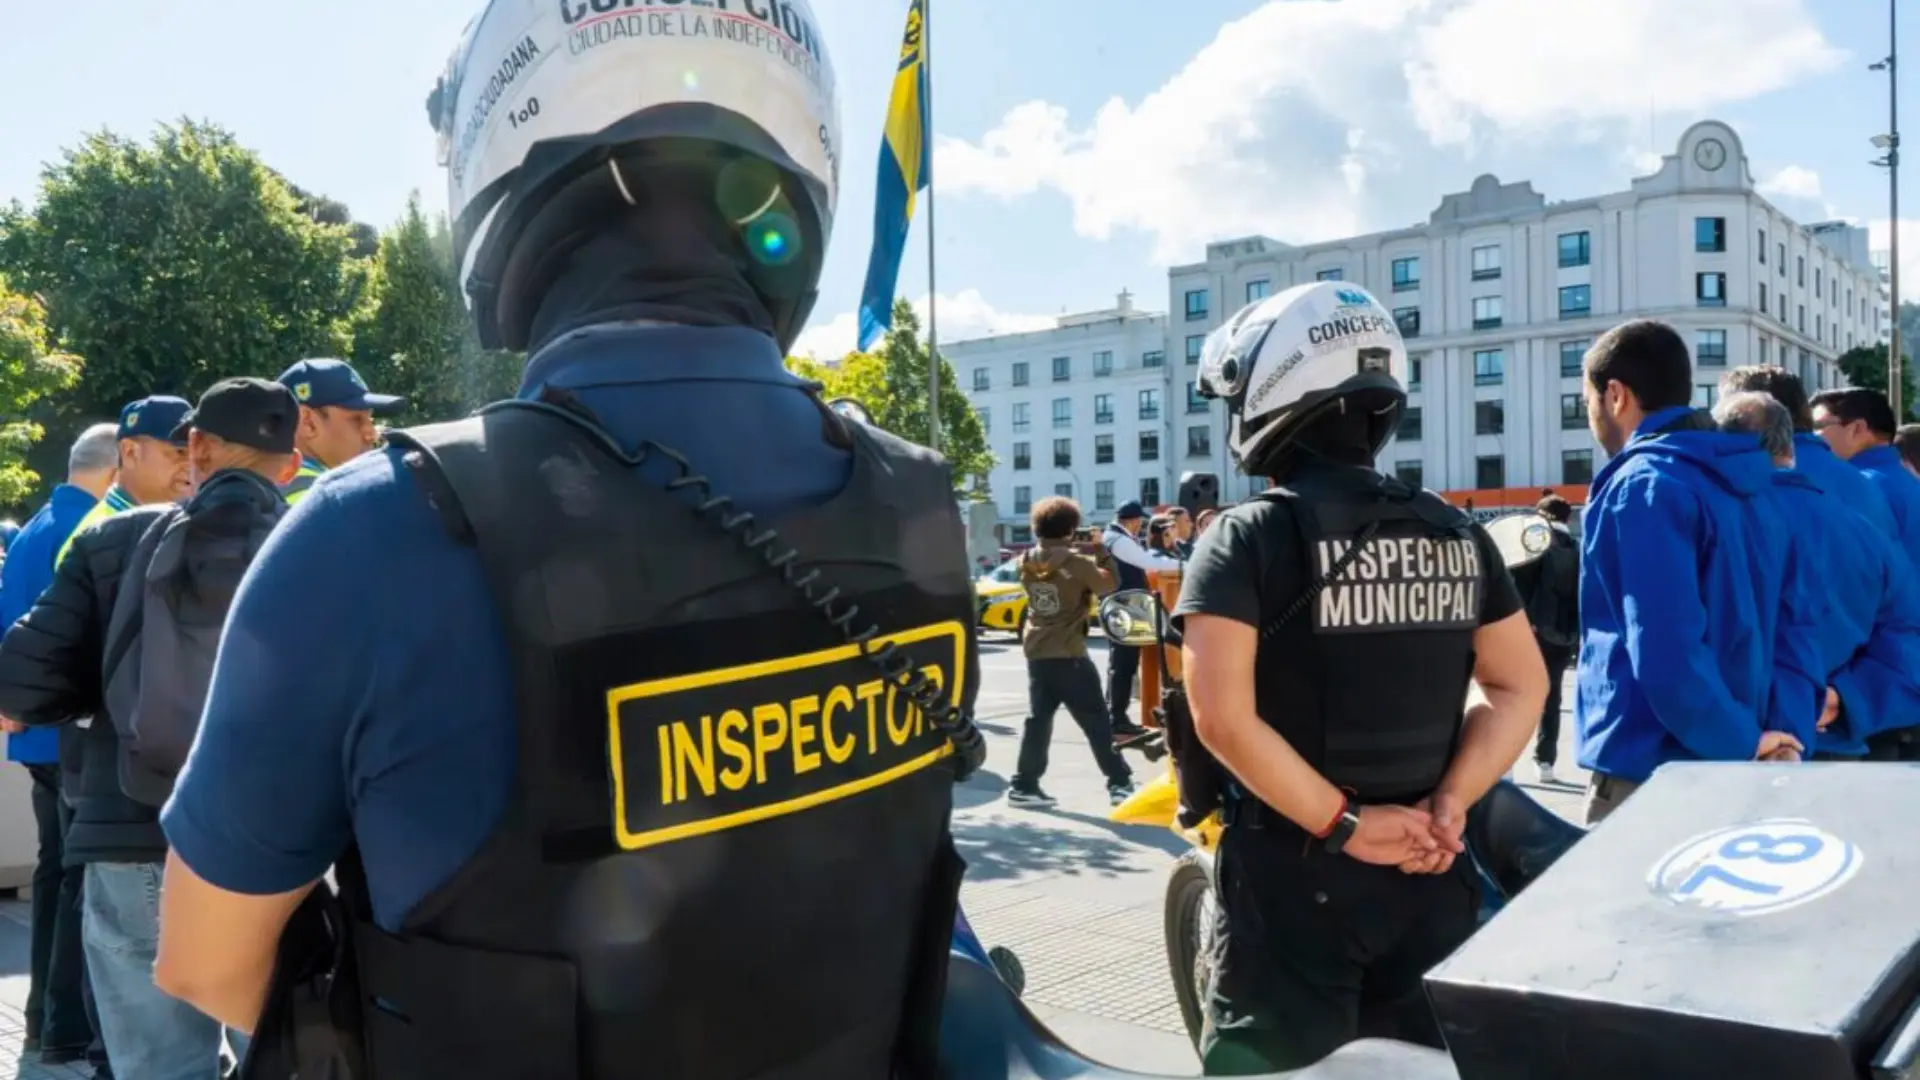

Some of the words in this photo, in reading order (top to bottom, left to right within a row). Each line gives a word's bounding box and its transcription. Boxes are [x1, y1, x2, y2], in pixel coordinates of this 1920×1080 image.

[568, 15, 642, 56] CIUDAD
[648, 13, 675, 37] DE
[680, 13, 708, 37] LA
[1318, 536, 1479, 581] INSPECTOR
[1320, 581, 1475, 628] MUNICIPAL
[1678, 833, 1824, 896] 78
